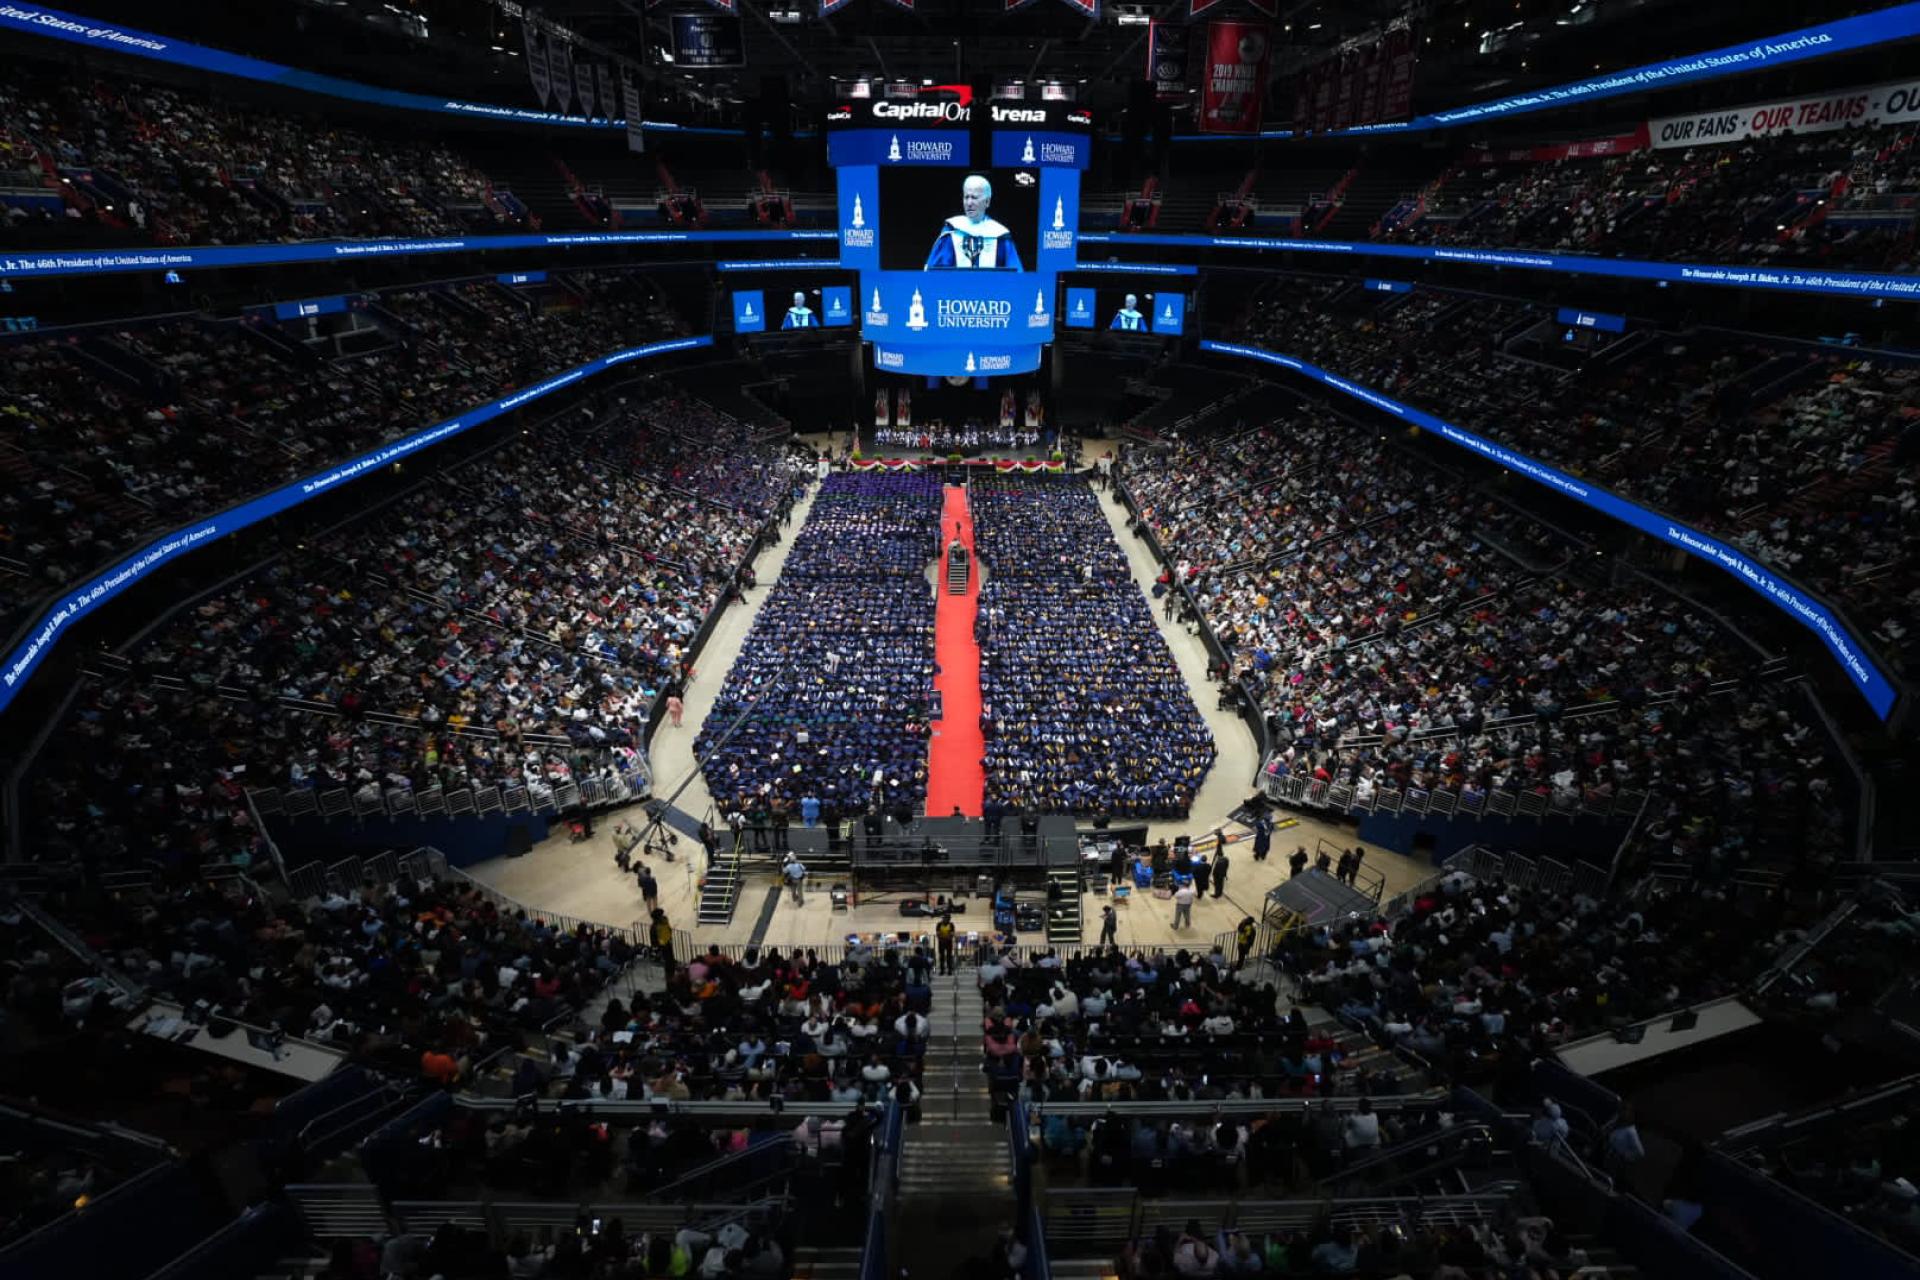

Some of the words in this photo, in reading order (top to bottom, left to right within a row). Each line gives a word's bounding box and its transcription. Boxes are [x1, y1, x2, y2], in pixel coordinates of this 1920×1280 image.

[32, 15, 88, 32] States
[87, 29, 113, 38] of
[101, 32, 167, 50] America
[1213, 64, 1233, 79] 2019
[1550, 91, 1570, 99] The
[1587, 78, 1637, 91] President
[1635, 72, 1649, 83] of
[1646, 69, 1666, 79] the
[1665, 61, 1708, 76] United
[1704, 53, 1749, 69] States
[1748, 47, 1767, 59] of
[1765, 33, 1833, 56] America
[991, 105, 1047, 122] Arena
[1661, 121, 1692, 141] OUR
[1696, 114, 1739, 138] FANS
[1751, 106, 1795, 131] OUR
[1797, 96, 1868, 126] TEAMS
[907, 141, 953, 151] HOWARD
[1041, 143, 1075, 154] HOWARD
[907, 150, 952, 161] UNIVERSITY
[1041, 152, 1075, 163] UNIVERSITY
[844, 228, 874, 238] HOWARD
[1043, 230, 1073, 240] HOWARD
[844, 237, 873, 247] UNIVERSITY
[1043, 239, 1072, 249] UNIVERSITY
[6, 260, 19, 270] Jr.
[18, 259, 36, 270] The
[37, 258, 57, 269] 46th
[56, 257, 95, 268] President
[94, 255, 103, 268] of
[102, 256, 115, 266] the
[114, 255, 140, 265] United
[138, 255, 160, 264] States
[167, 254, 193, 263] America
[1682, 268, 1693, 277] The
[1692, 269, 1726, 280] Honorable
[1725, 271, 1749, 283] Joseph
[1757, 273, 1780, 284] Biden,
[1780, 274, 1791, 284] Jr.
[1791, 275, 1805, 285] The
[1805, 276, 1822, 287] 46th
[1822, 276, 1860, 289] President
[1860, 279, 1873, 291] of
[1870, 278, 1883, 290] the
[1884, 281, 1917, 293] United
[937, 299, 1011, 315] HOWARD
[937, 314, 1010, 328] UNIVERSITY
[4, 671, 17, 687] The
[13, 644, 38, 676] Honorable
[36, 627, 52, 649] Joseph
[52, 610, 70, 627] Biden,
[68, 602, 79, 614] Jr.
[77, 594, 91, 608] The
[90, 584, 106, 600] 46th
[104, 568, 132, 591] President
[136, 559, 146, 572] the
[144, 548, 164, 566] United
[162, 540, 181, 555] States
[181, 534, 190, 547] of
[188, 526, 216, 543] America
[1668, 527, 1681, 539] The
[1680, 532, 1718, 556] Honorable
[1717, 549, 1738, 568] Joseph
[1742, 564, 1760, 583] Biden,
[1766, 580, 1777, 594] The
[1789, 596, 1818, 621] President
[1851, 657, 1869, 683] America
